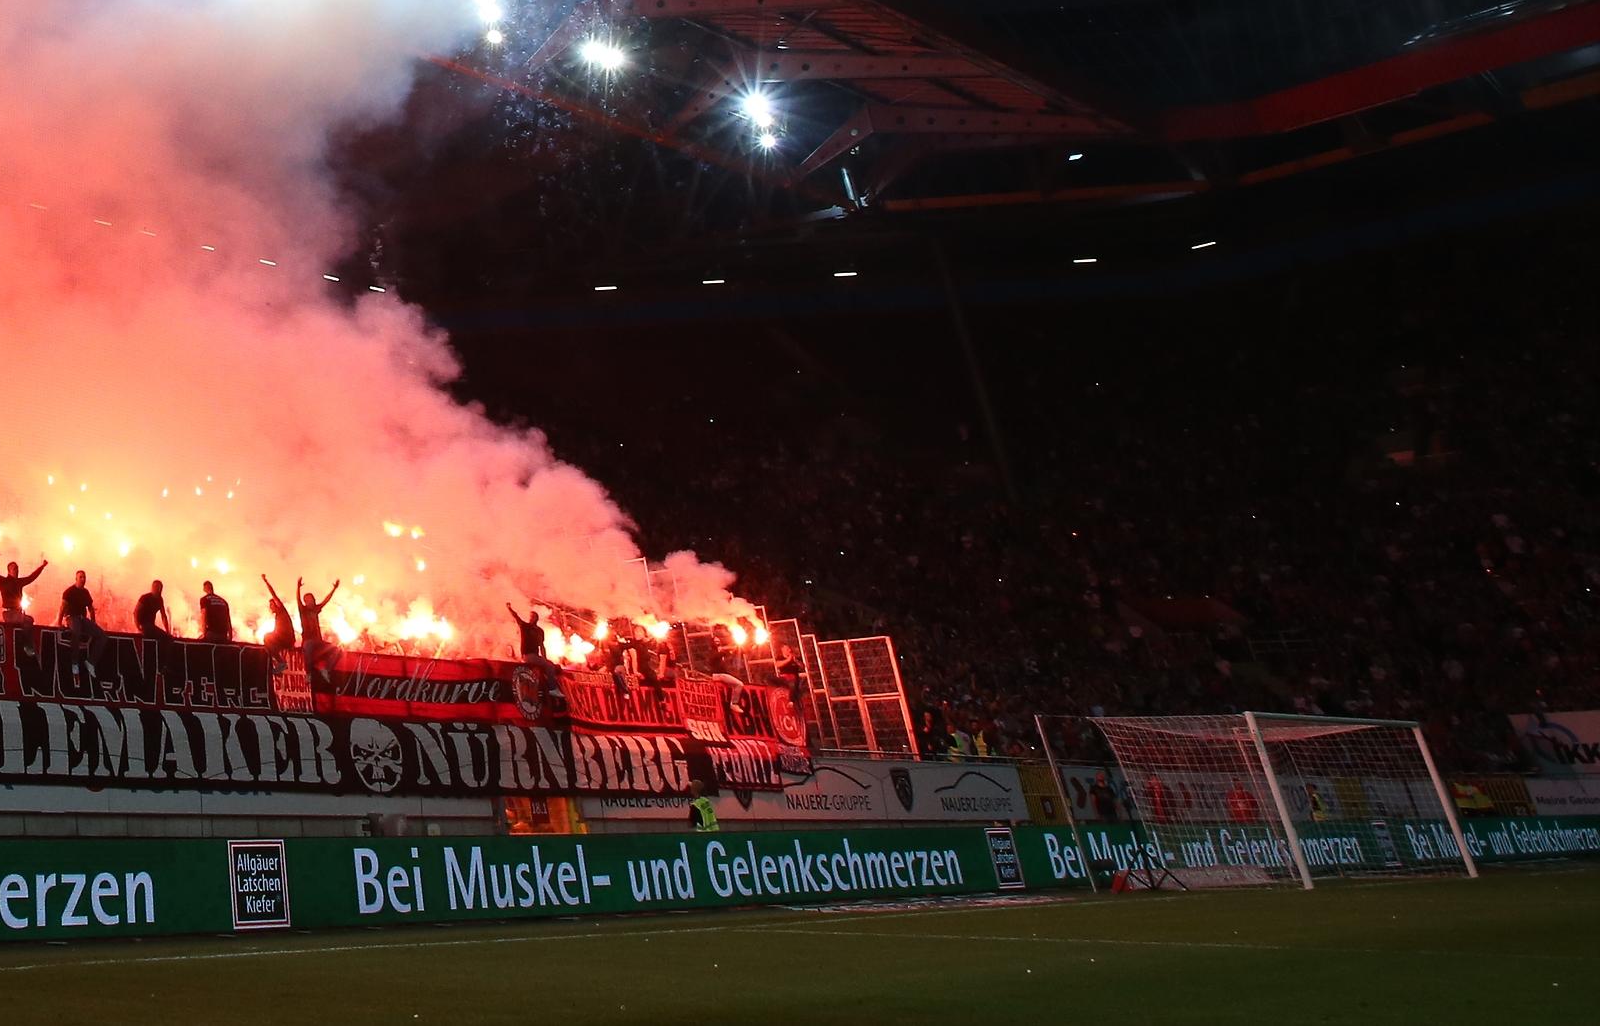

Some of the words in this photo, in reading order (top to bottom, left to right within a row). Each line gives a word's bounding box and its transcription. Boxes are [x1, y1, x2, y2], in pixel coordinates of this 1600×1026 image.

[336, 652, 502, 705] Nordkurve
[686, 719, 727, 742] SGN
[402, 721, 691, 793] NÜRNBERG
[600, 797, 695, 809] NAUERZ-GRUPP
[786, 795, 873, 811] NAUERZ-GRUPPE
[941, 797, 1014, 812] NAUERZ-GRUPPE
[1488, 821, 1516, 855] und
[237, 854, 279, 876] Allgäuer
[237, 875, 281, 892] Latschen
[354, 847, 426, 916] Bei
[446, 843, 612, 912] Muskel-
[627, 842, 696, 903] und
[705, 837, 964, 898] Gelenkschmerzen
[246, 895, 276, 913] Kiefer
